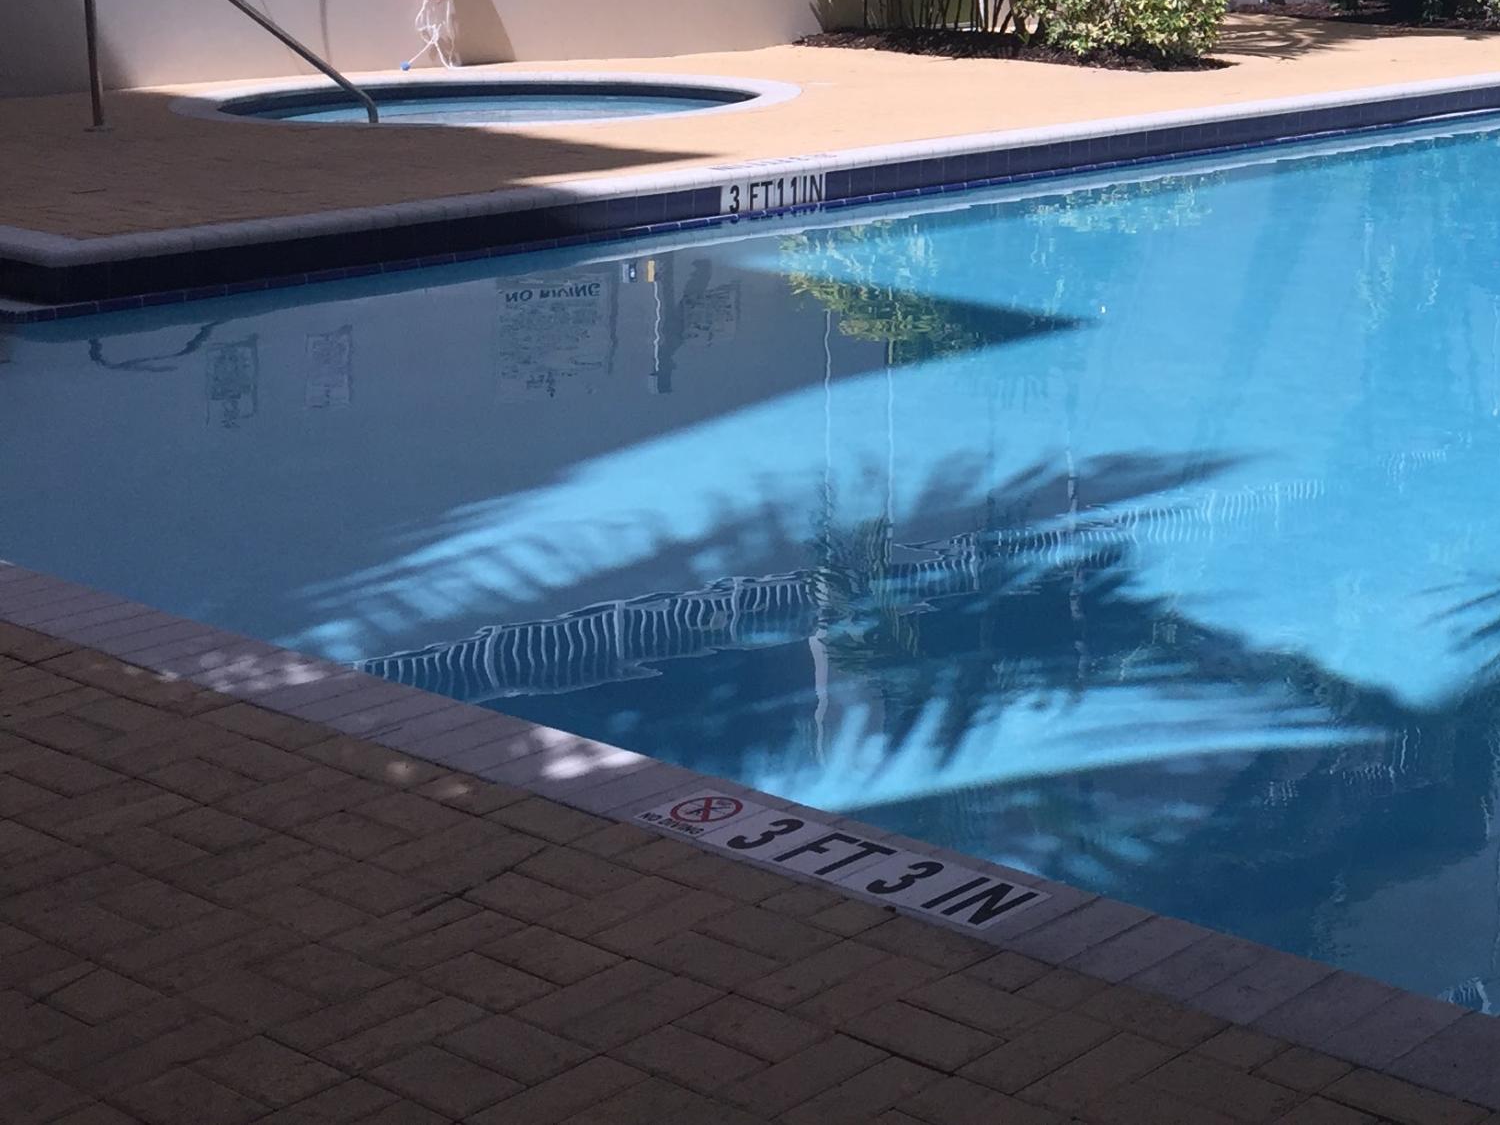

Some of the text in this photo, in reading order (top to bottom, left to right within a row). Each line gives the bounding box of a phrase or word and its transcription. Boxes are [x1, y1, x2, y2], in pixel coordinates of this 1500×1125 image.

[729, 185, 739, 213] 3
[640, 812, 704, 834] NO DIVING
[726, 818, 1038, 926] 3 FT 3 IN
